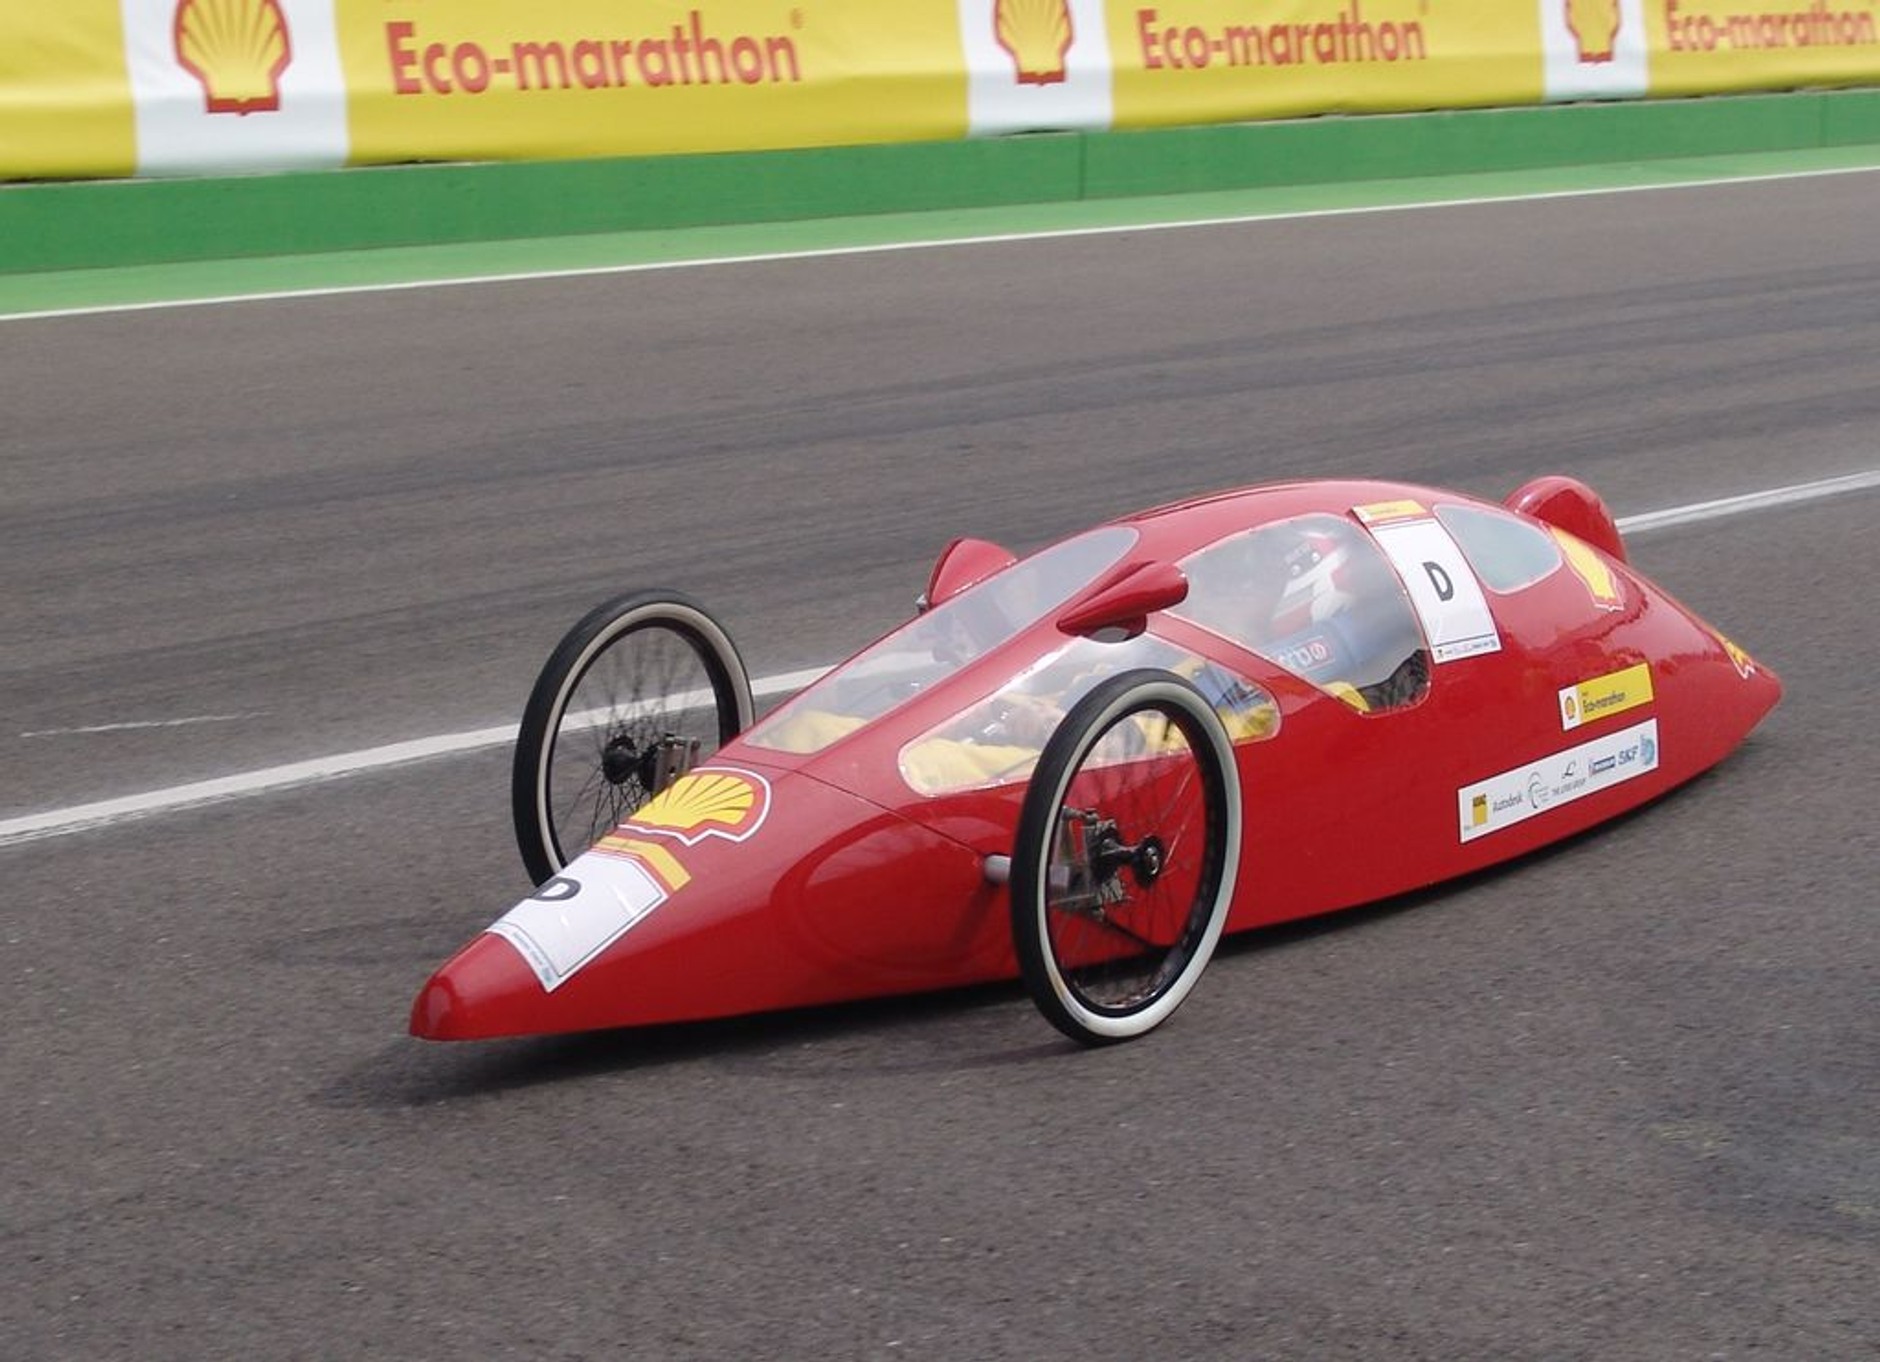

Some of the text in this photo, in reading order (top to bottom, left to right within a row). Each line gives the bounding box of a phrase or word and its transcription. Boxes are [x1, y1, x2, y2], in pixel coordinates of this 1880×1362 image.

[384, 9, 801, 95] Eco-marathon
[1135, 0, 1428, 69] Eco-marathon
[1422, 561, 1454, 602] D
[532, 876, 581, 901] D
